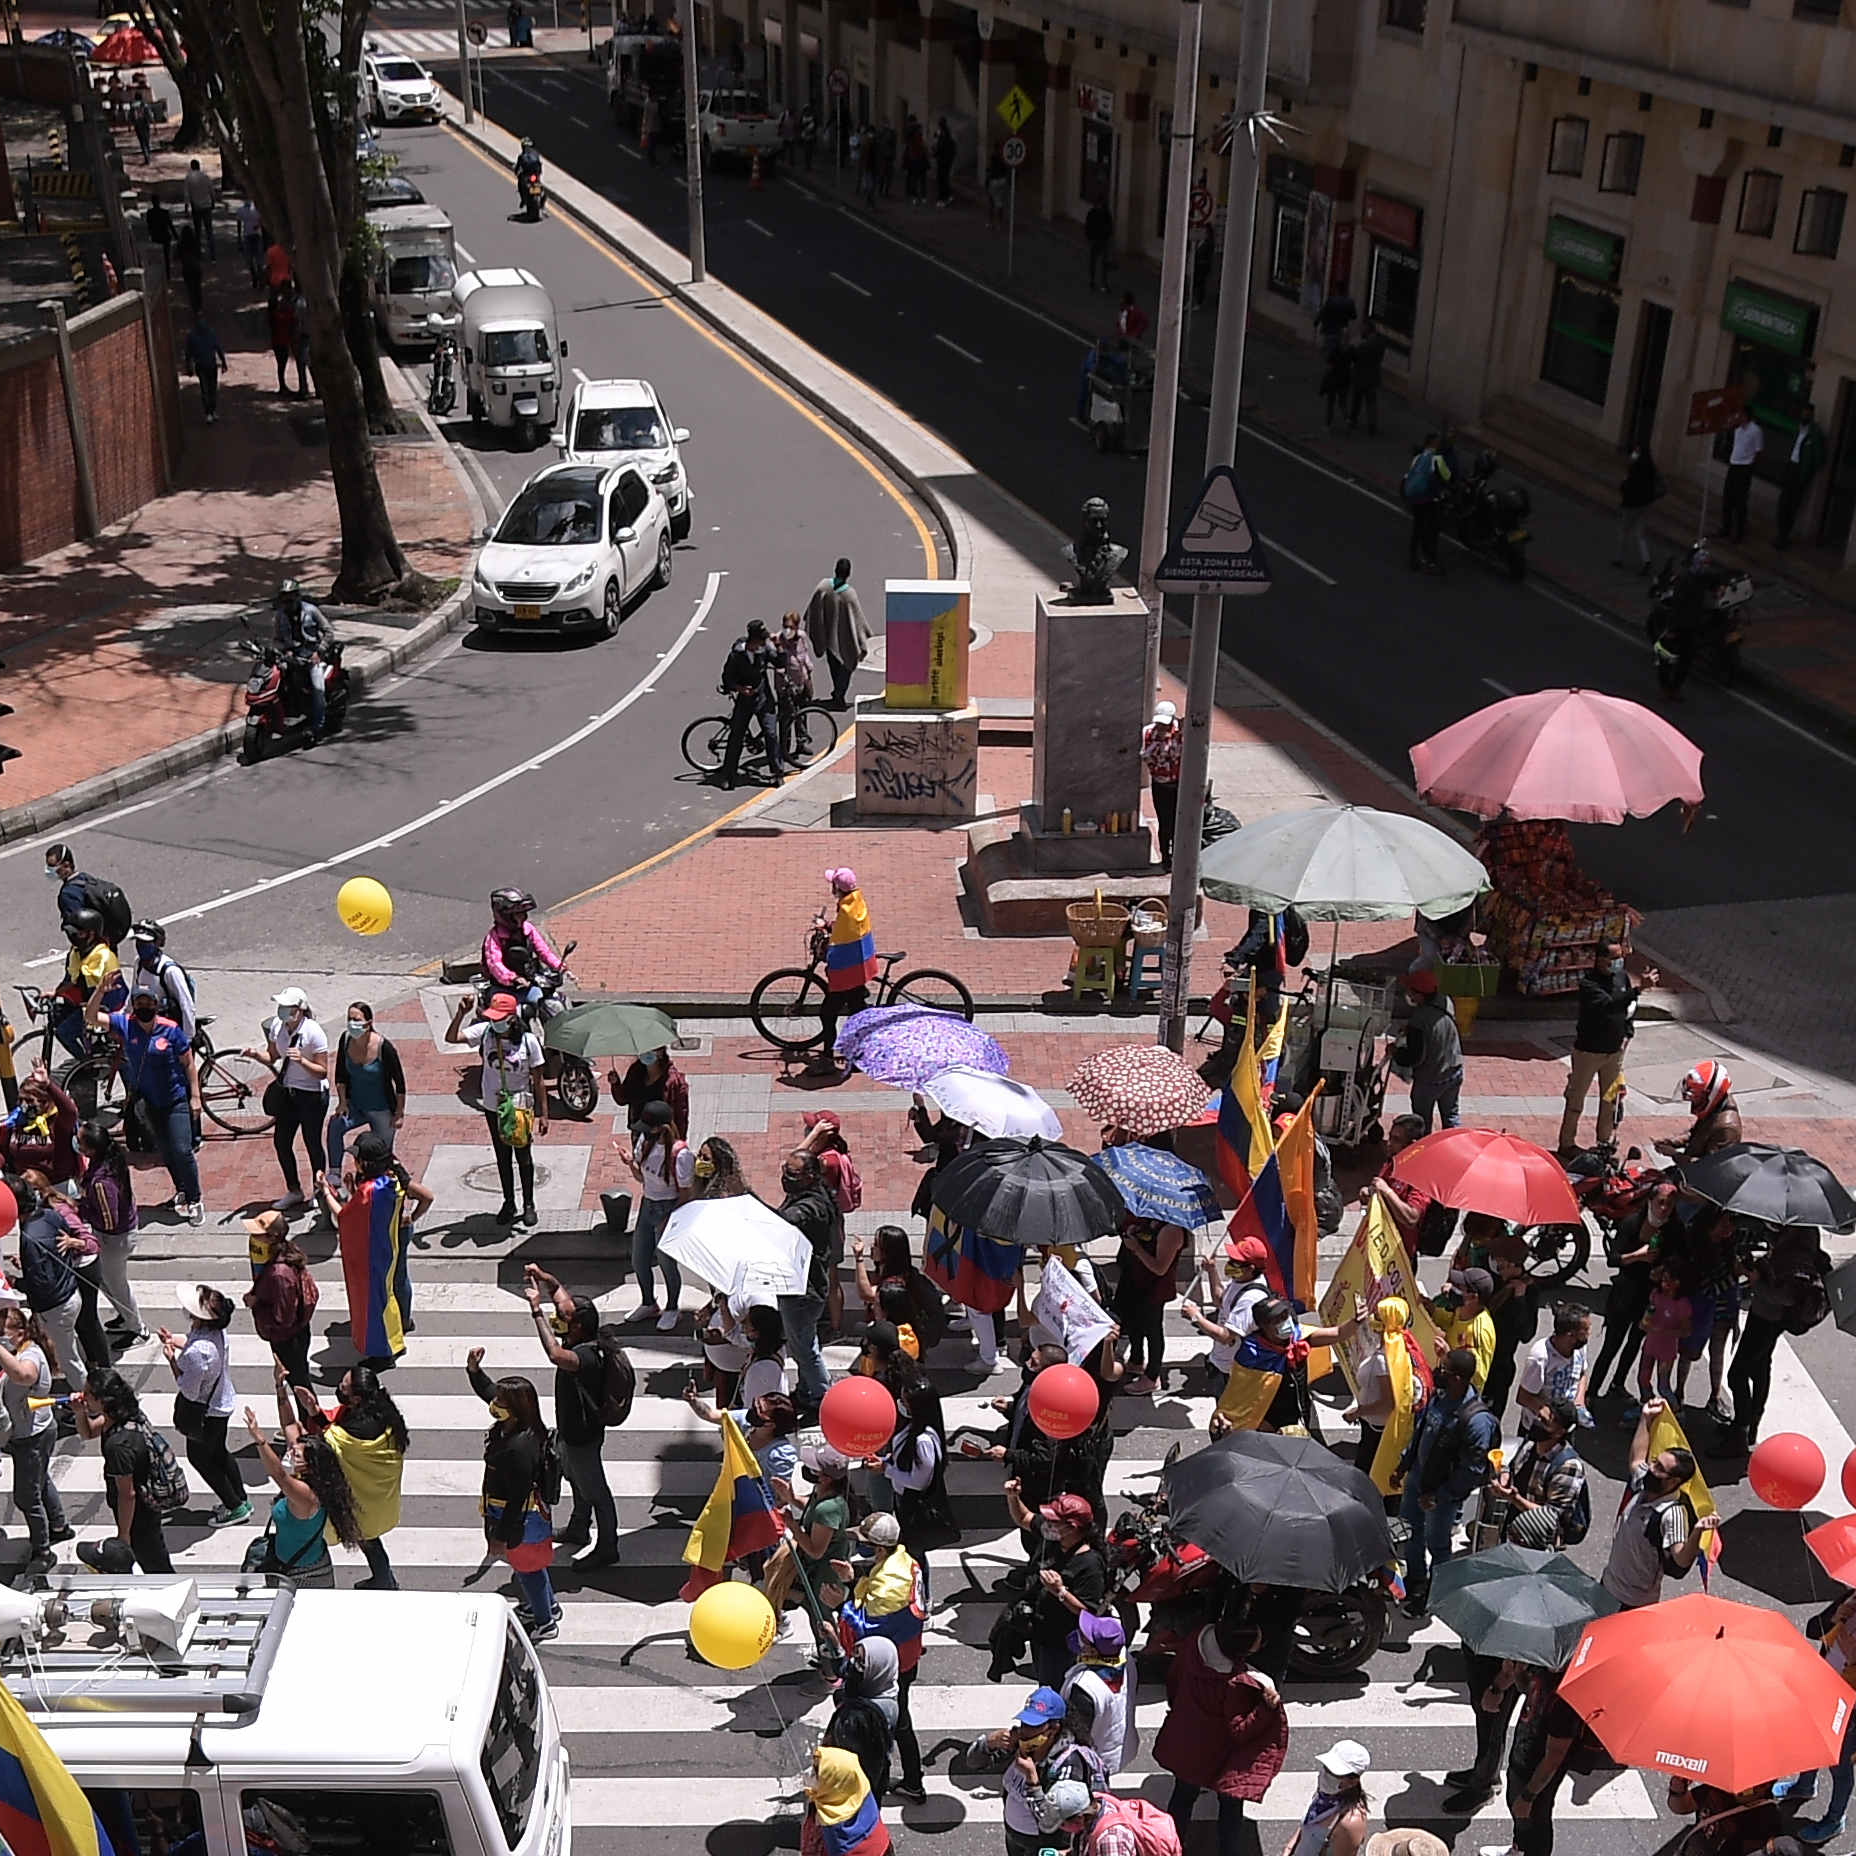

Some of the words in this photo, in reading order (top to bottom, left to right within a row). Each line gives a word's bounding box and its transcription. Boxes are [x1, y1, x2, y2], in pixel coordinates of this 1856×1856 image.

[1007, 143, 1023, 159] 30
[1179, 557, 1201, 567] ESTA
[1204, 557, 1228, 567] ZONA
[1164, 567, 1196, 577] SIENDO
[1199, 568, 1265, 579] MONITOREADA
[1655, 1750, 1708, 1774] maxell
